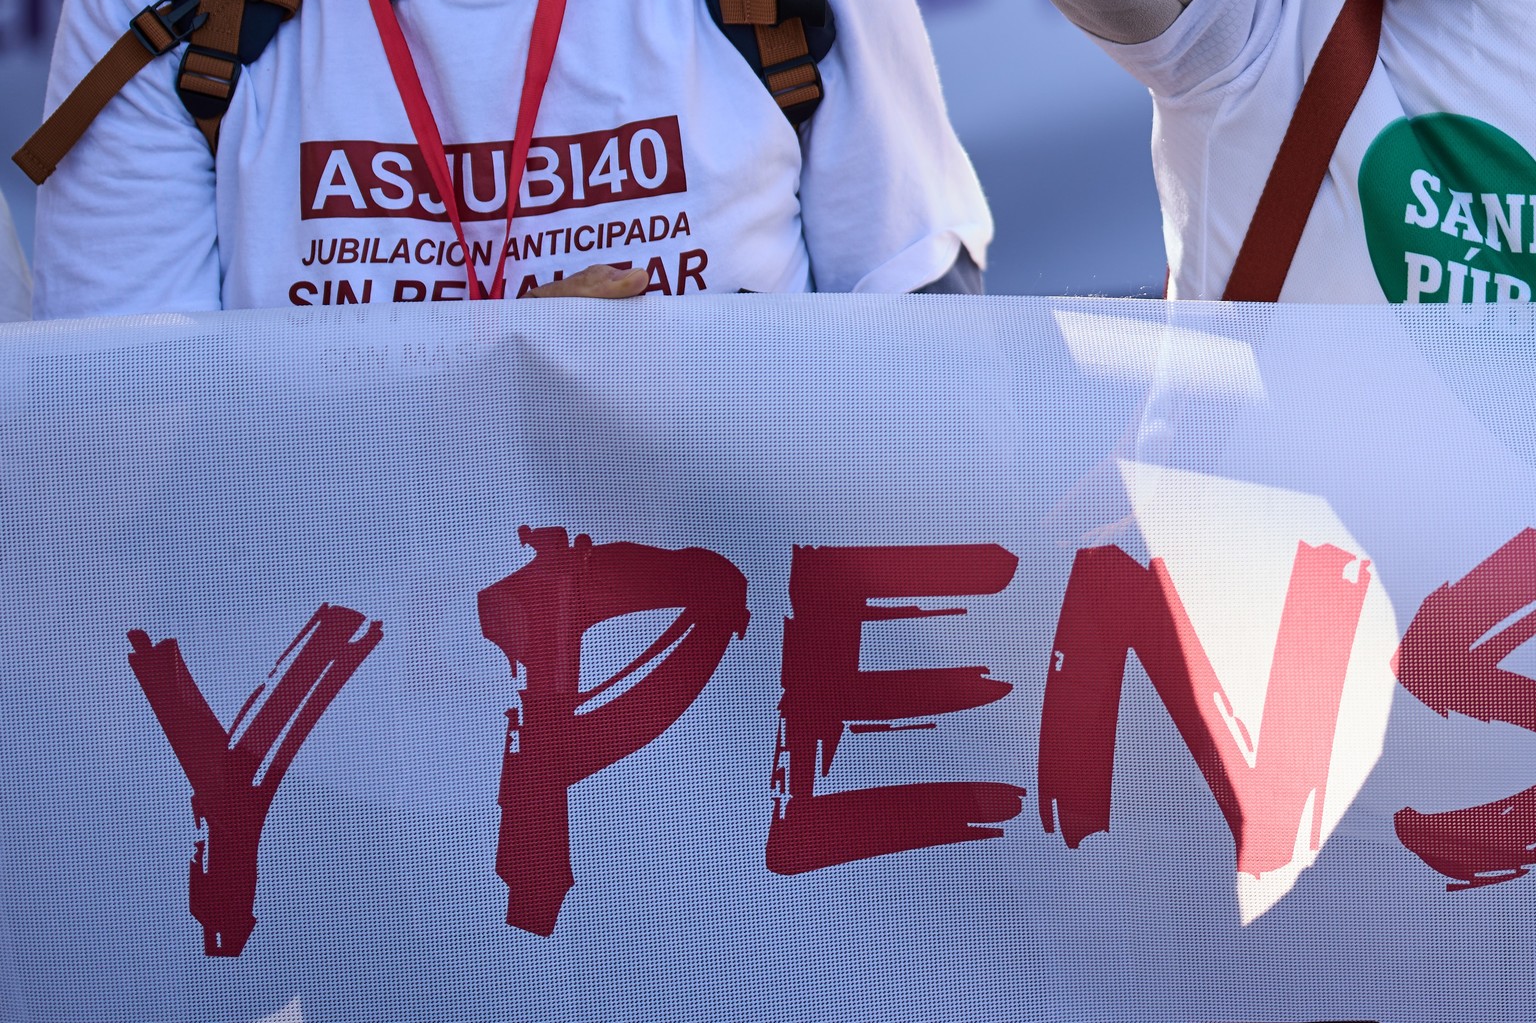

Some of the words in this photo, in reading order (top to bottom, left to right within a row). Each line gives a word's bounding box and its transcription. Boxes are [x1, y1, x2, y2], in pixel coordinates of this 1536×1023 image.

[311, 128, 669, 214] ASJUBI40
[505, 211, 691, 261] ANTICIPADA
[127, 602, 384, 957] Y
